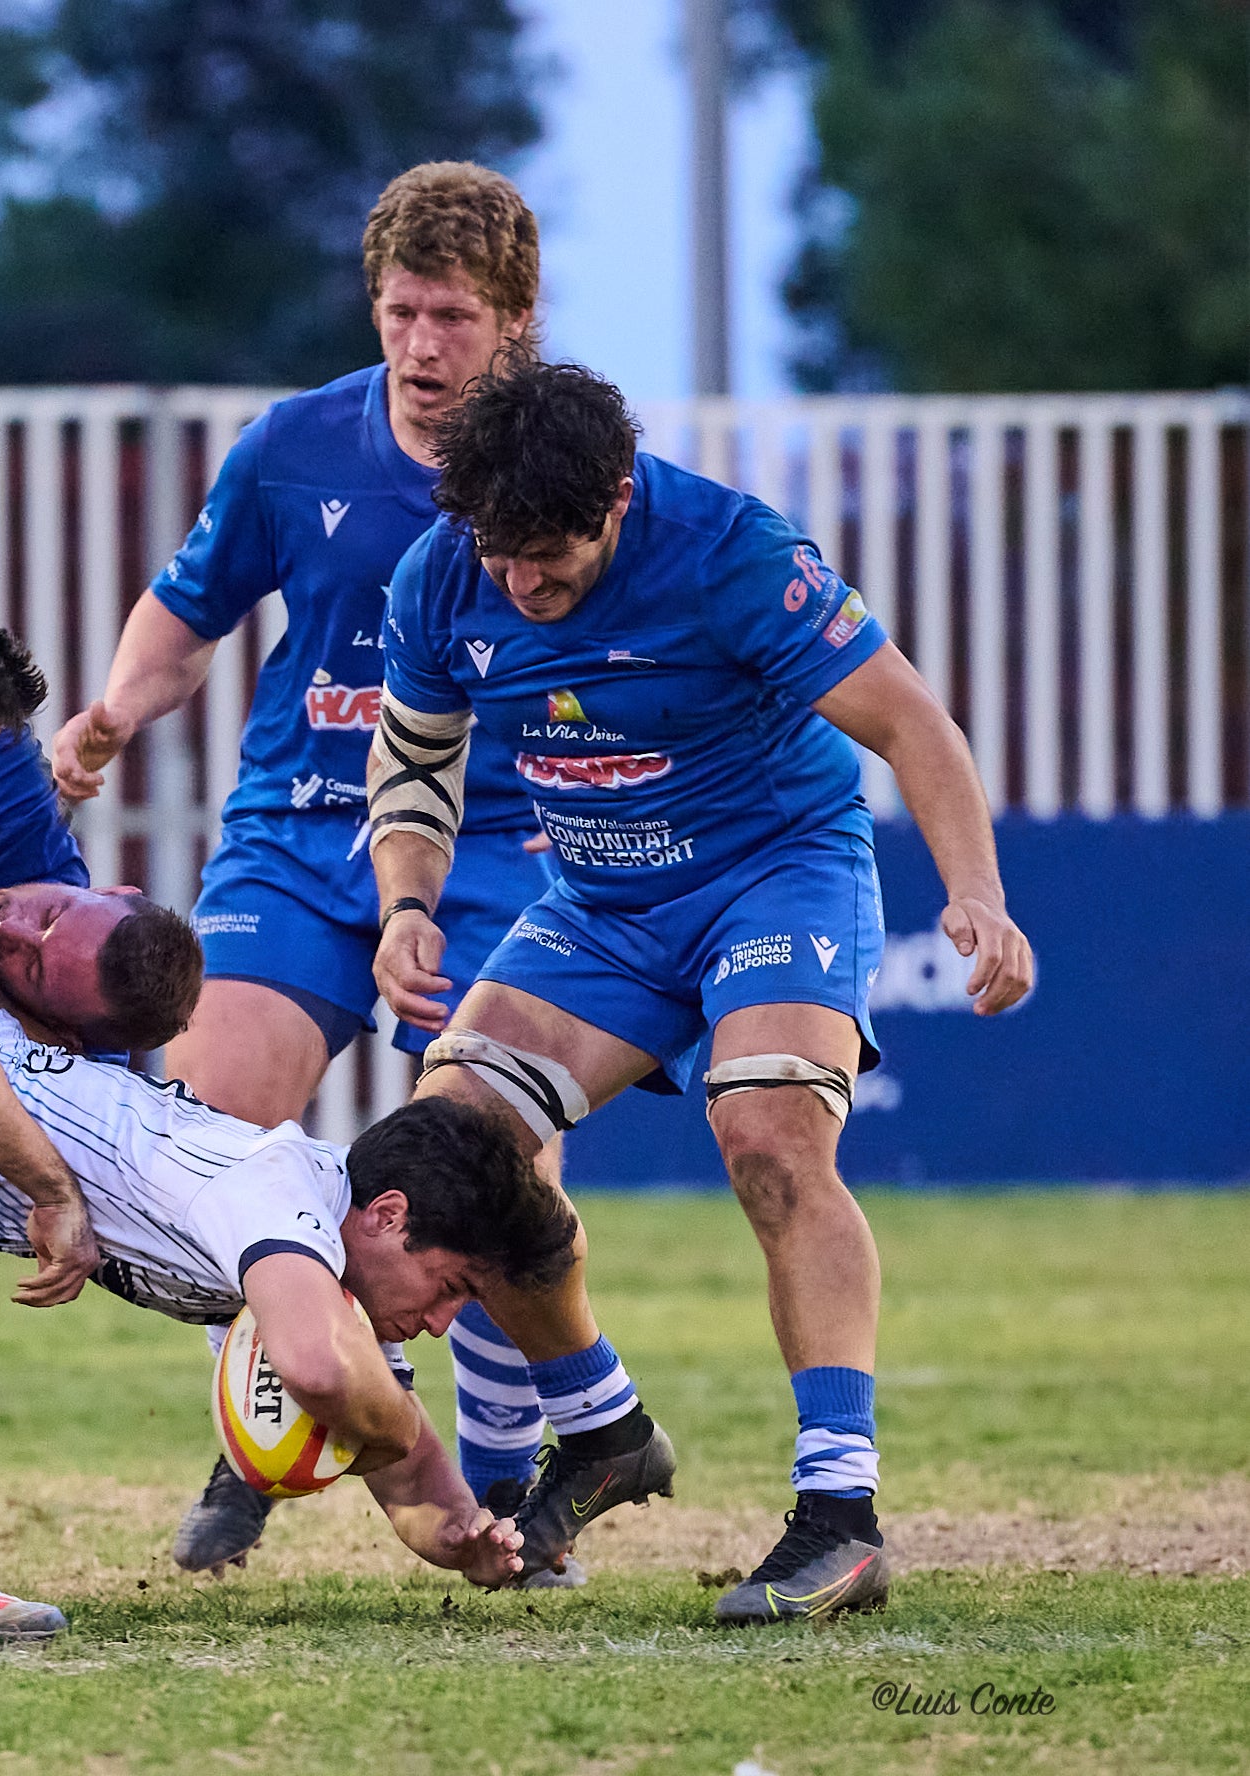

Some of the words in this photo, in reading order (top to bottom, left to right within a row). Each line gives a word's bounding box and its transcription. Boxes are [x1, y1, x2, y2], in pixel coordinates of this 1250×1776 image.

[522, 723, 542, 738] La
[546, 724, 579, 739] Vila
[541, 806, 596, 829] Comunitat
[597, 818, 669, 831] Valenciana
[546, 821, 672, 851] COMUNITAT
[558, 843, 586, 866] DE
[587, 838, 693, 867] L'ESPORT
[730, 933, 791, 953] FUNDACIÓN
[731, 943, 792, 964] TRINIDAD
[731, 953, 792, 976] ALFONSO
